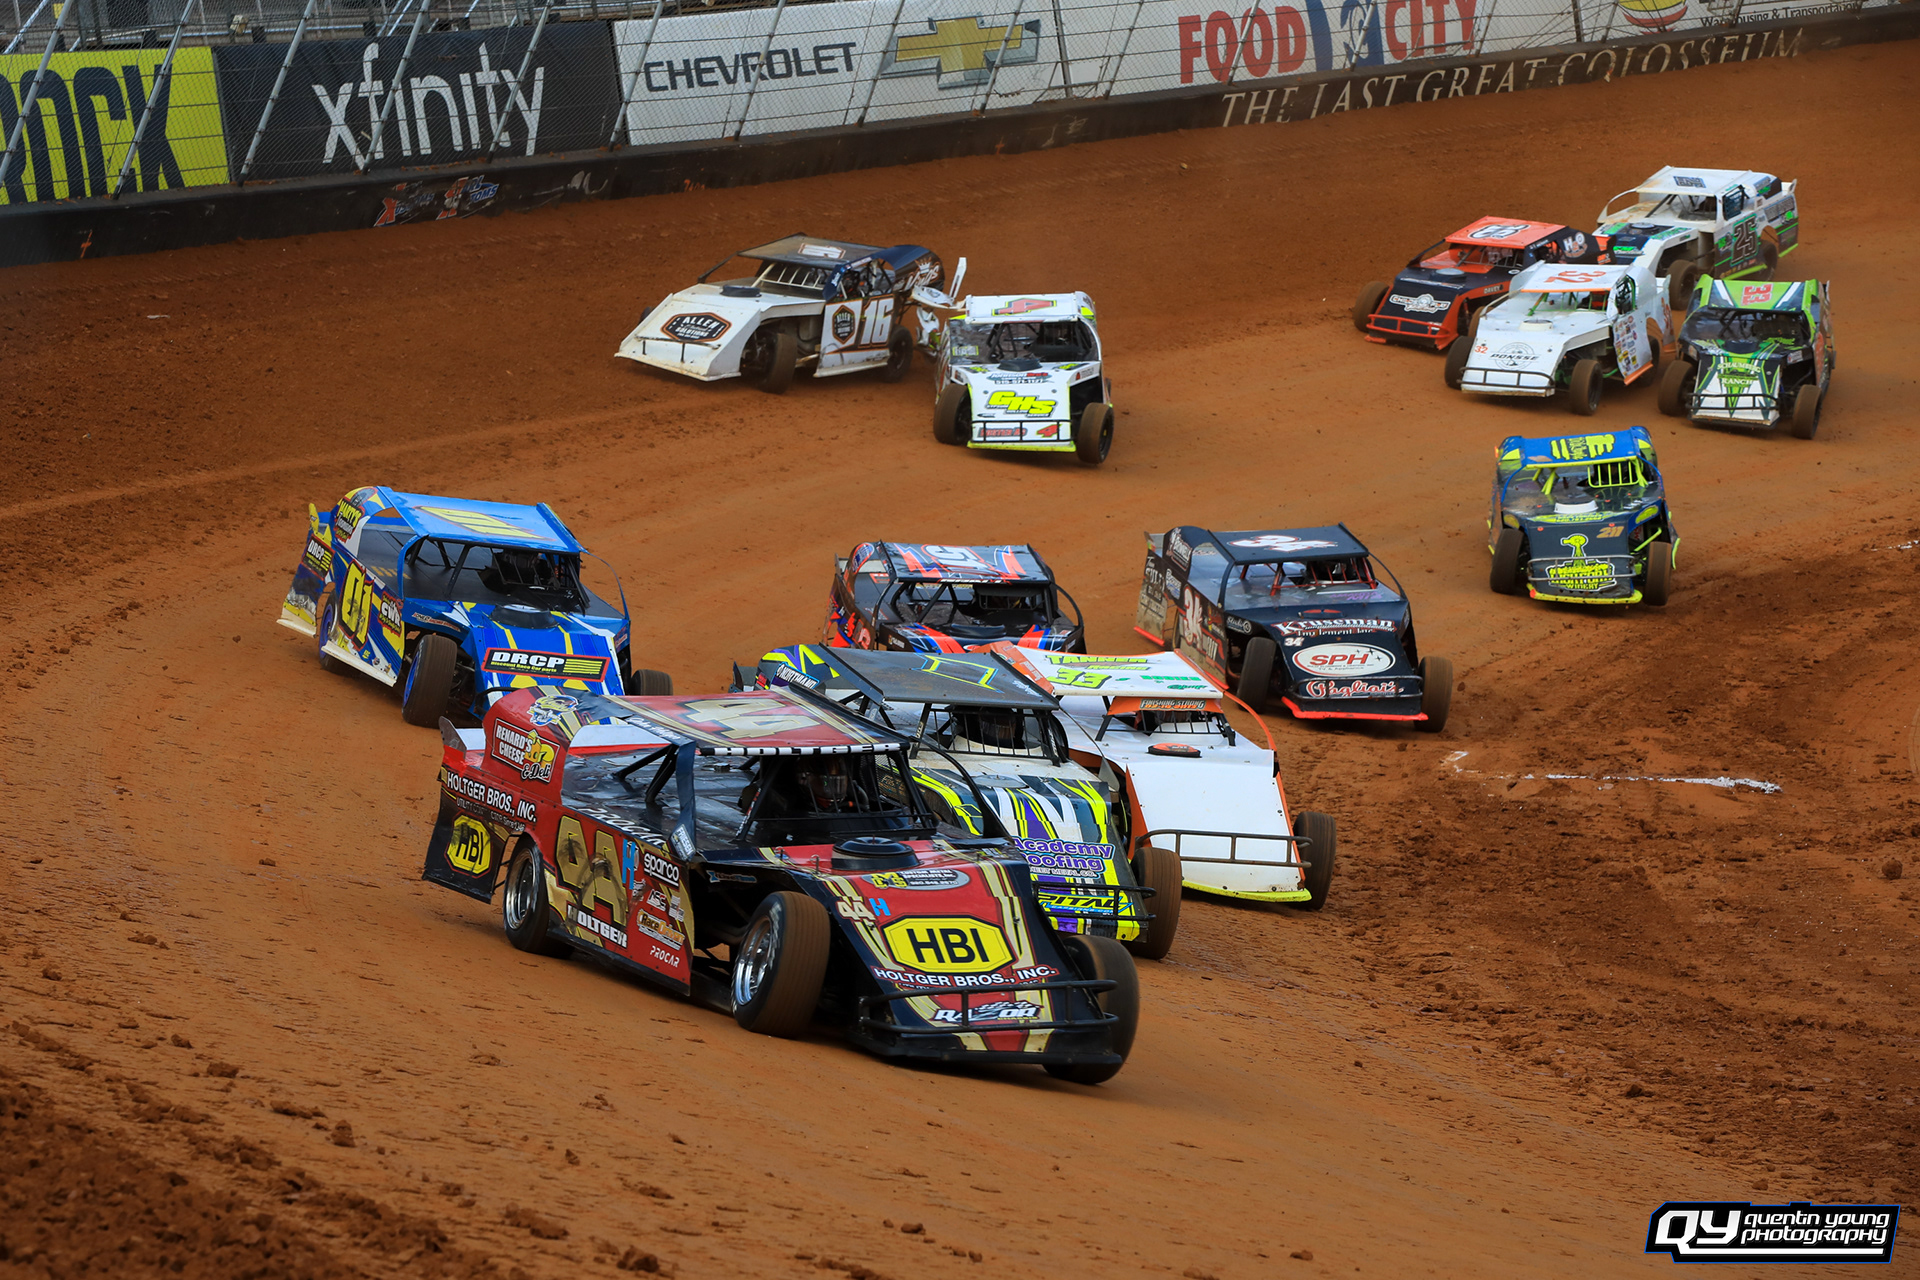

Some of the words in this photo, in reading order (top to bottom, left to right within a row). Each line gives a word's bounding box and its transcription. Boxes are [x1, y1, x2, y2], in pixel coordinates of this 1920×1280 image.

[1178, 6, 1308, 84] FOOD
[1385, 0, 1477, 61] CITY
[644, 42, 856, 92] CHEVROLET
[1221, 86, 1299, 128] THE
[1310, 75, 1407, 119] LAST
[1416, 58, 1548, 104] GREAT
[312, 42, 545, 170] xfinity
[1732, 213, 1758, 265] 25
[682, 316, 720, 329] ALLEN
[859, 299, 894, 346] 16
[1475, 345, 1488, 355] 32
[1721, 377, 1753, 386] RANCH
[988, 391, 1056, 415] GHS
[1036, 424, 1061, 438] 4
[1275, 618, 1394, 636] Kruseman
[491, 651, 565, 668] DRCP
[1046, 655, 1148, 665] TANNER
[1309, 654, 1369, 666] SPH
[1047, 668, 1112, 689] 33
[495, 724, 533, 753] RENARD'S
[499, 740, 526, 765] CHEESE
[447, 771, 485, 802] HOLTGER
[517, 799, 537, 823] INC.
[455, 823, 484, 866] HBI
[1014, 837, 1113, 858] Academy
[643, 853, 679, 881] sparco
[1021, 852, 1104, 871] oofing
[837, 901, 876, 921] 44
[567, 903, 628, 948] HOLTGER
[649, 945, 680, 968] PROCAR
[905, 928, 990, 963] HBI
[873, 967, 951, 986] HOLTGER
[1016, 966, 1057, 980] INC.
